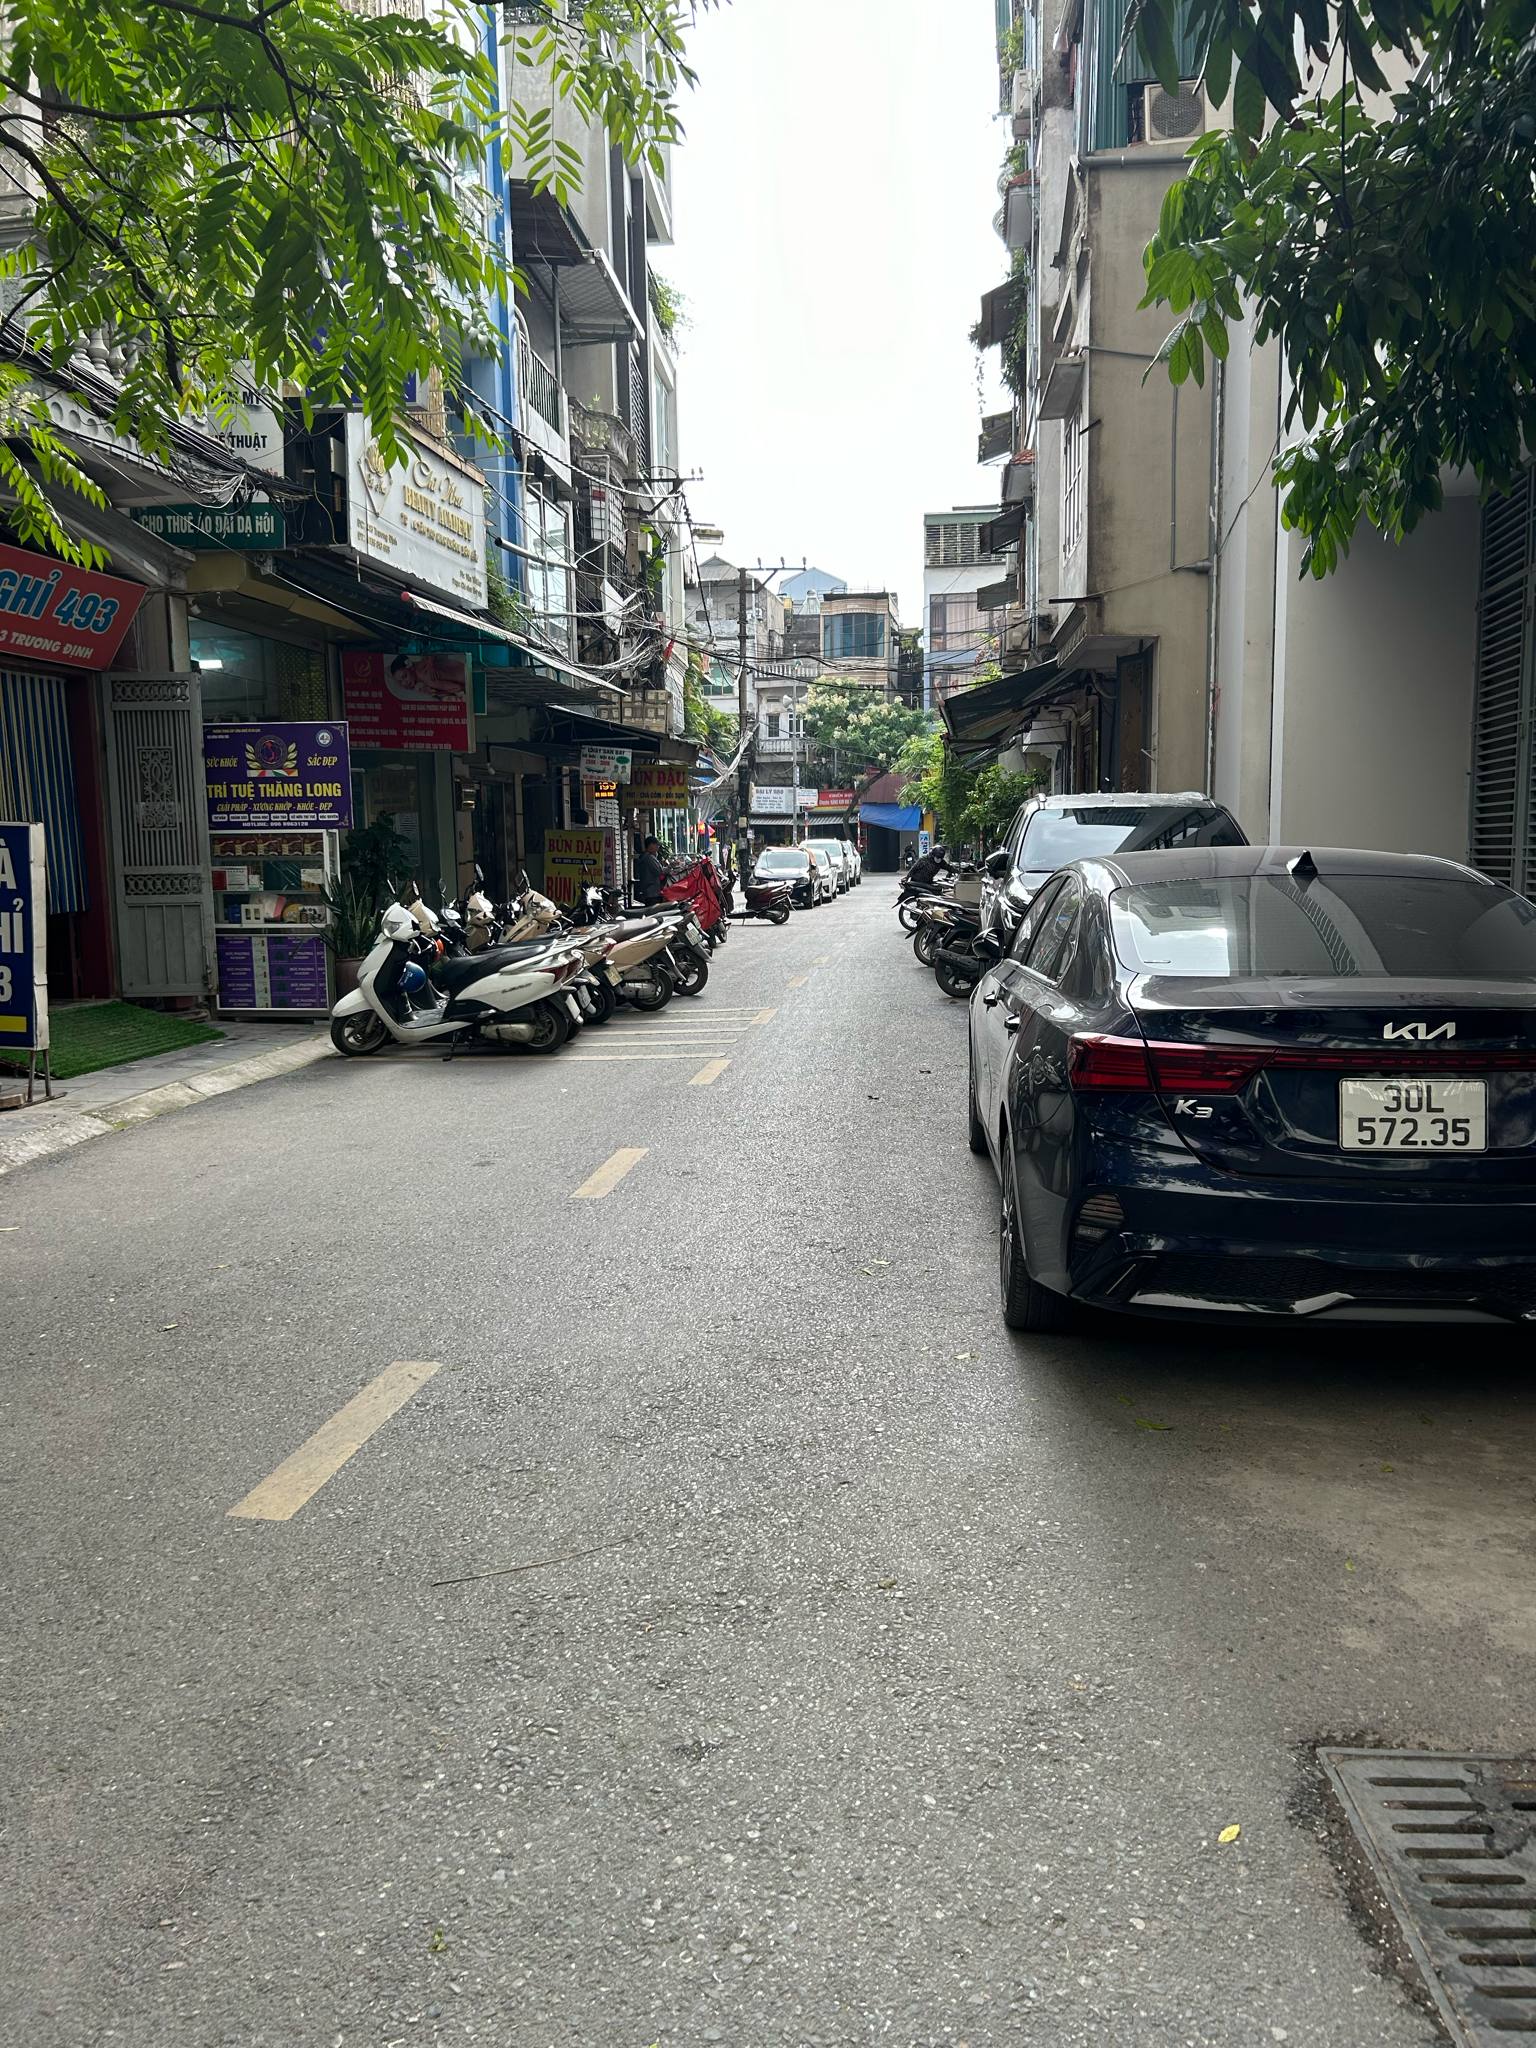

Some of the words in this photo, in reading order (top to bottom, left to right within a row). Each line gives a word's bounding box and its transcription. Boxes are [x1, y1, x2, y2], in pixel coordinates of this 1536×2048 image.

[231, 432, 267, 451] THUẬT
[52, 587, 119, 634] 493
[62, 643, 94, 659] ĐỊNH
[207, 782, 226, 798] TRÍ
[231, 781, 255, 800] TUỆ
[258, 781, 302, 797] THĂNG
[306, 783, 342, 797] LONG
[1383, 1022, 1456, 1040] KIA
[1383, 1085, 1445, 1113] 30L
[1175, 1099, 1213, 1119] K3
[1357, 1117, 1471, 1147] 572.35
